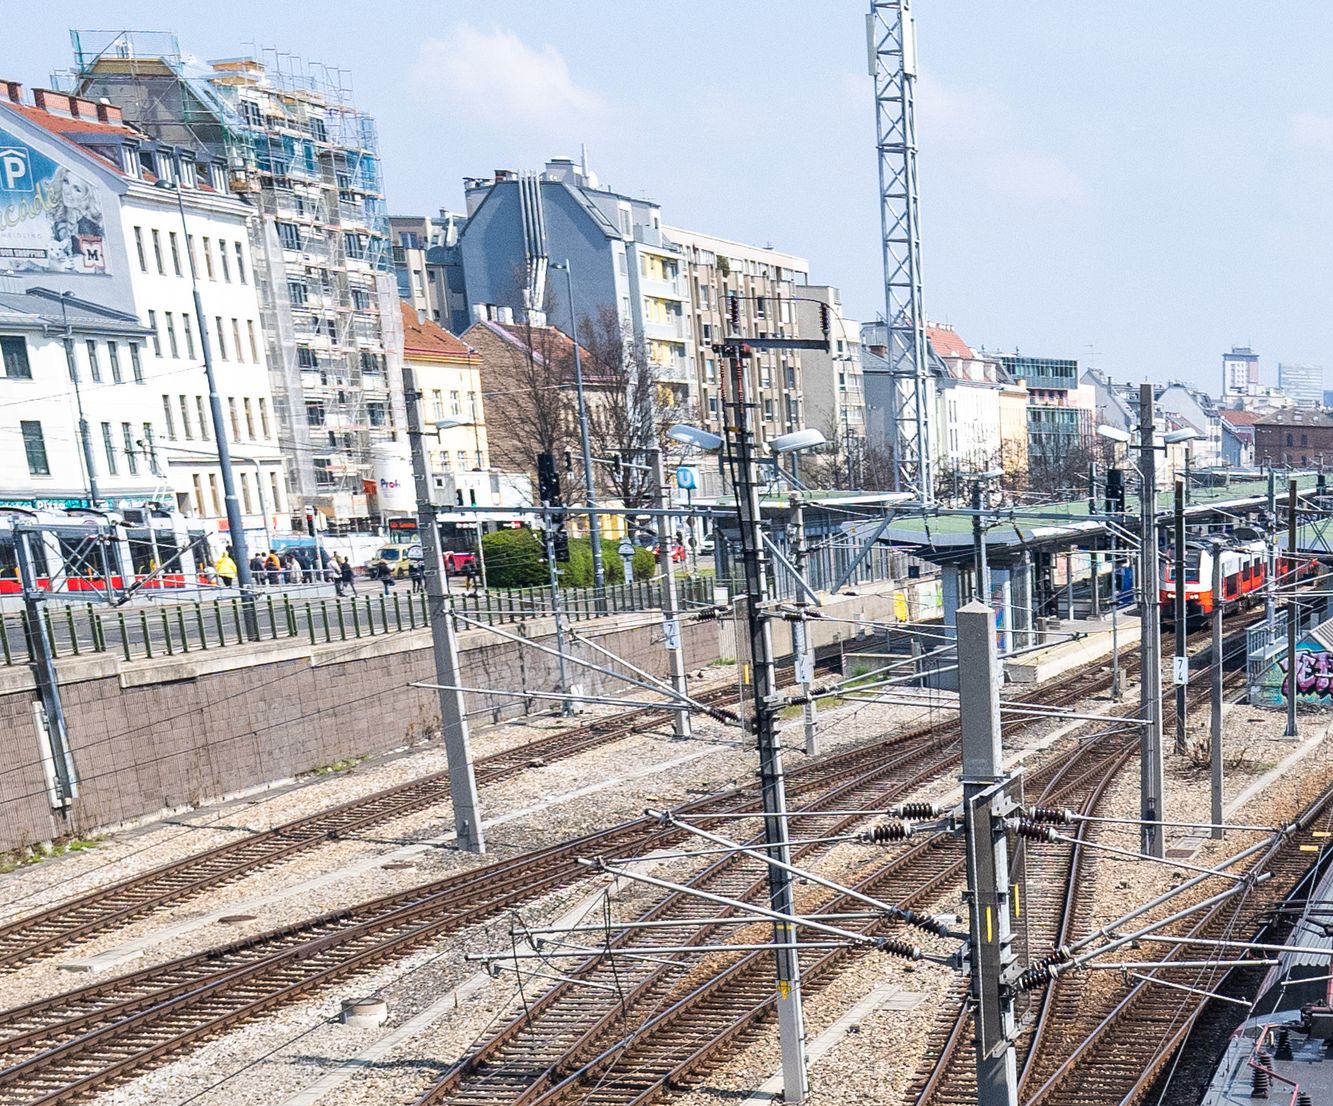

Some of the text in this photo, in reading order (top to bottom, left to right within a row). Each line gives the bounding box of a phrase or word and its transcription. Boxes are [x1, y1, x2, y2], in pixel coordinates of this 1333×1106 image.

[3, 156, 26, 188] P
[86, 249, 99, 261] M
[680, 470, 692, 487] U
